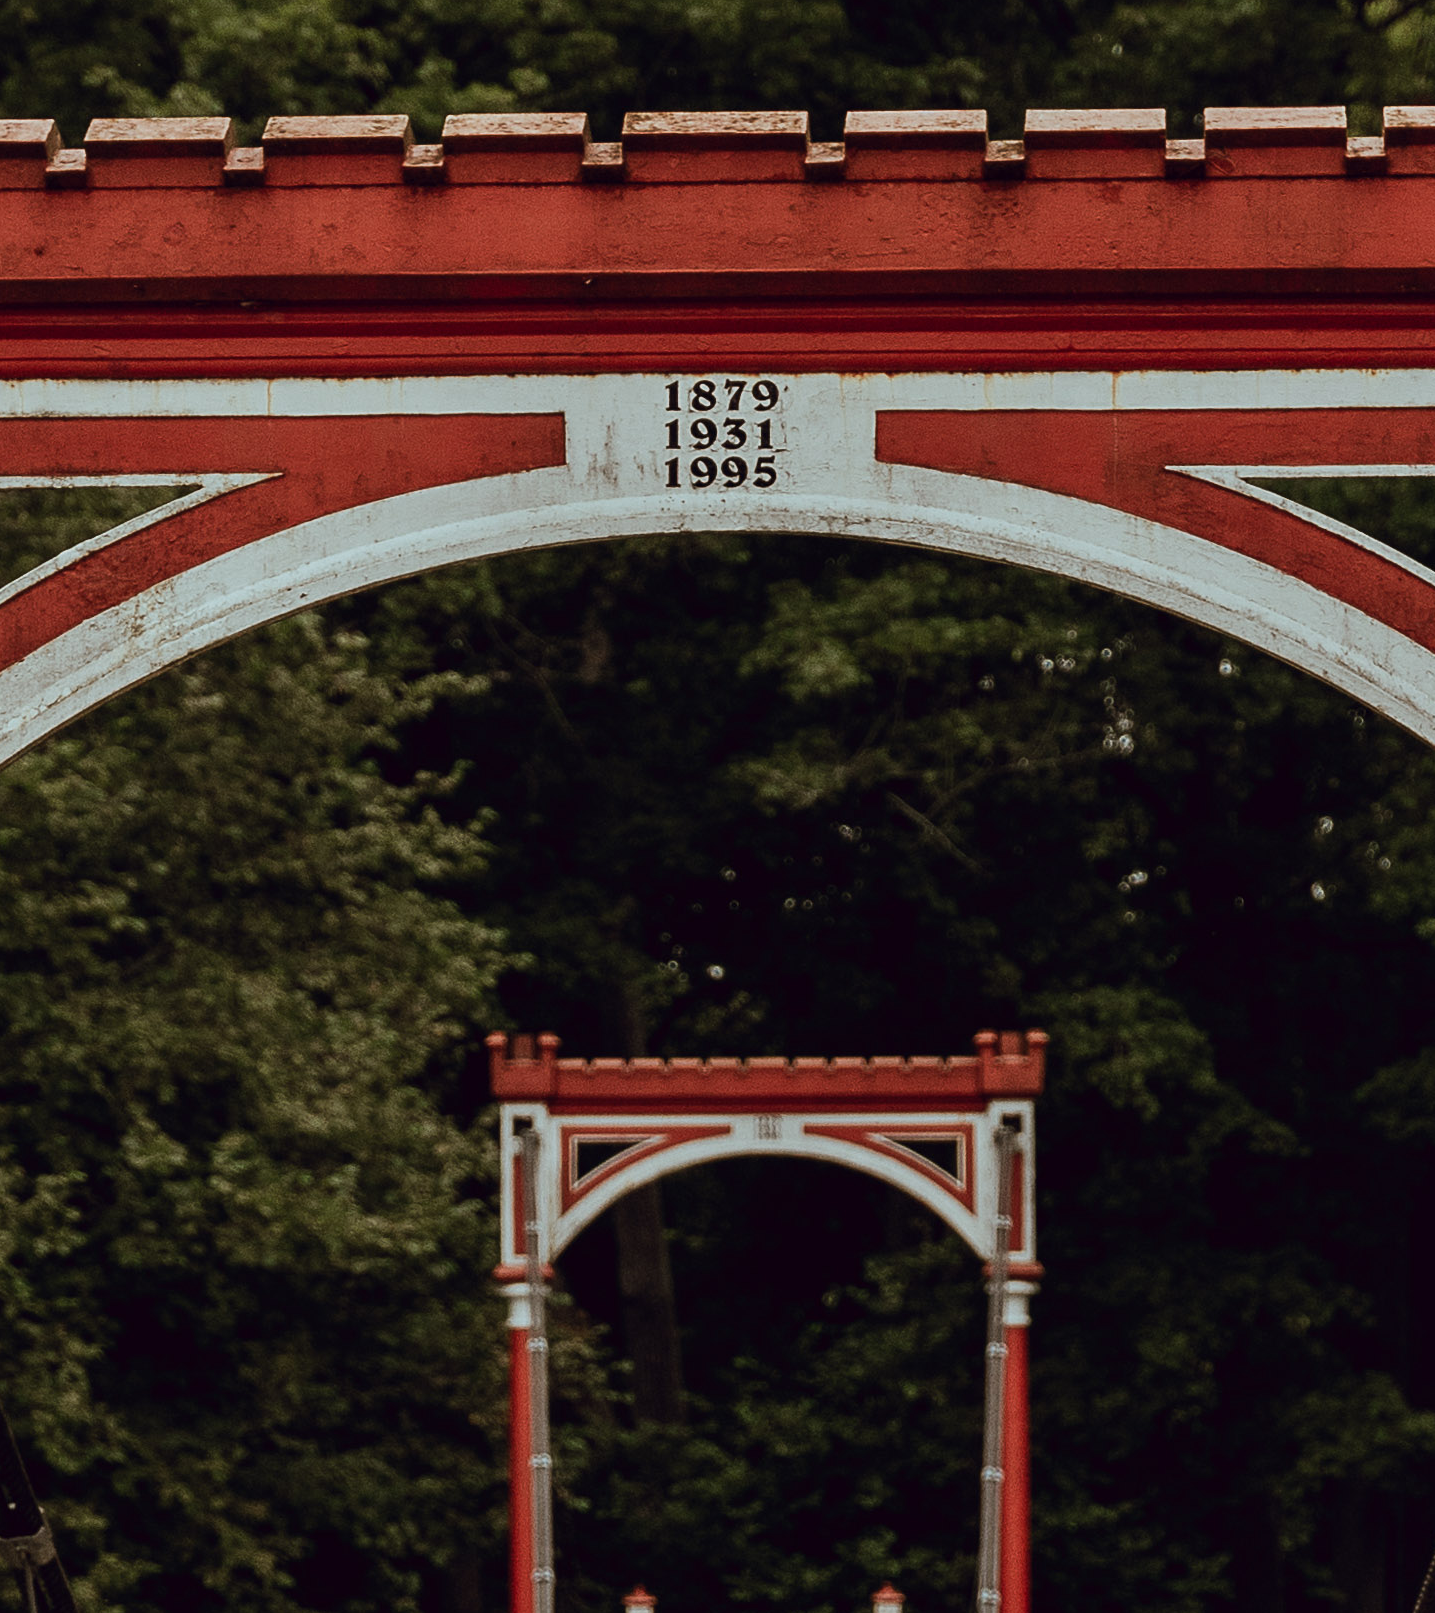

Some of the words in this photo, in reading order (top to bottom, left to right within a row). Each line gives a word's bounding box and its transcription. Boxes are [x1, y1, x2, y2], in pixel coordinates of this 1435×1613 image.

[665, 379, 779, 412] 1879
[665, 418, 773, 450] 1931
[665, 456, 777, 488] 1995
